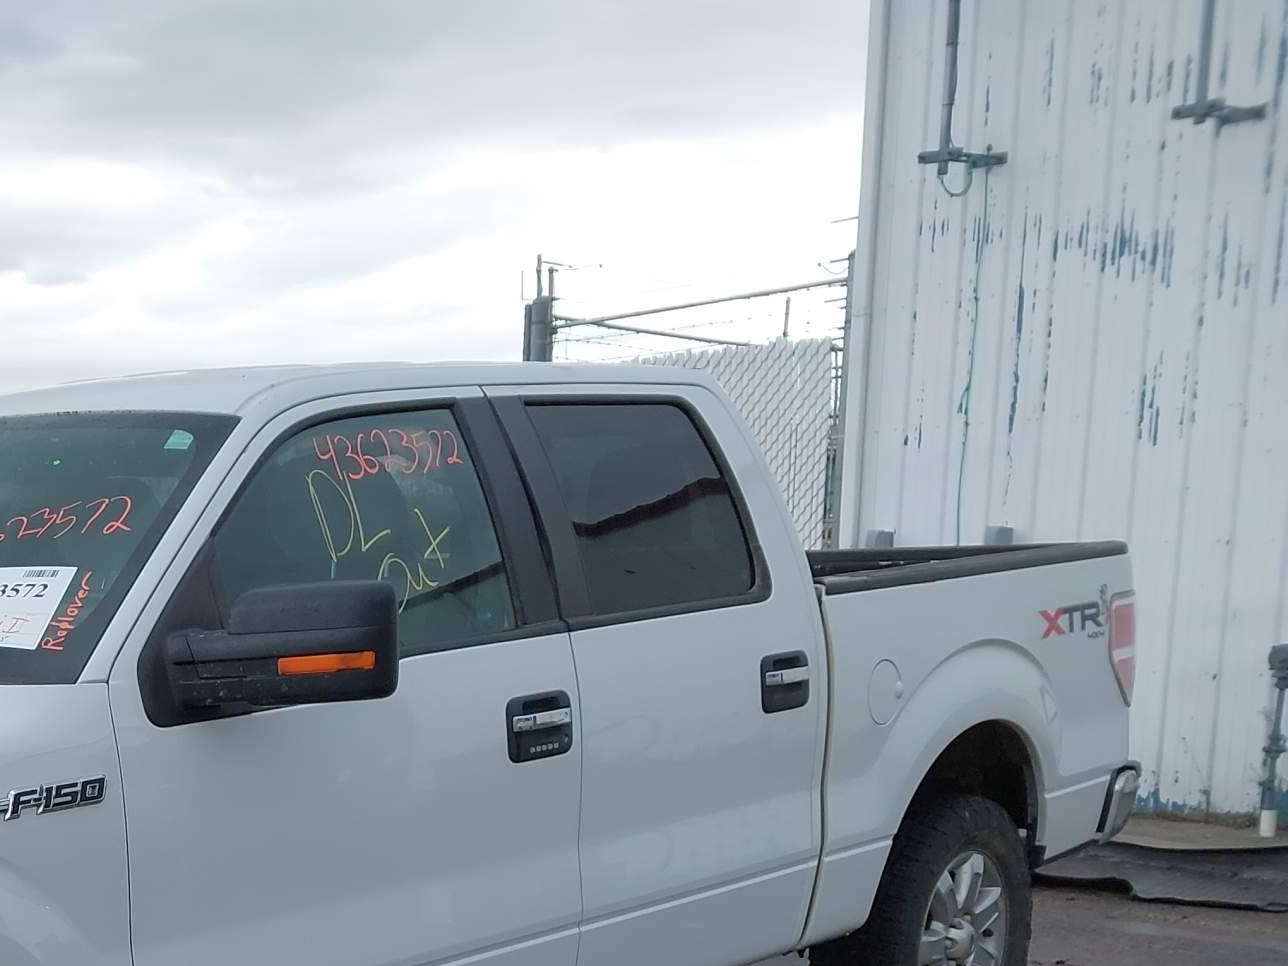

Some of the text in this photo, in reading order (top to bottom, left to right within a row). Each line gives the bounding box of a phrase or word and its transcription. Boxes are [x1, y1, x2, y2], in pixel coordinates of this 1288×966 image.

[313, 429, 463, 480] 43623572
[1038, 601, 1104, 640] XTR
[4, 774, 106, 821] F-150
